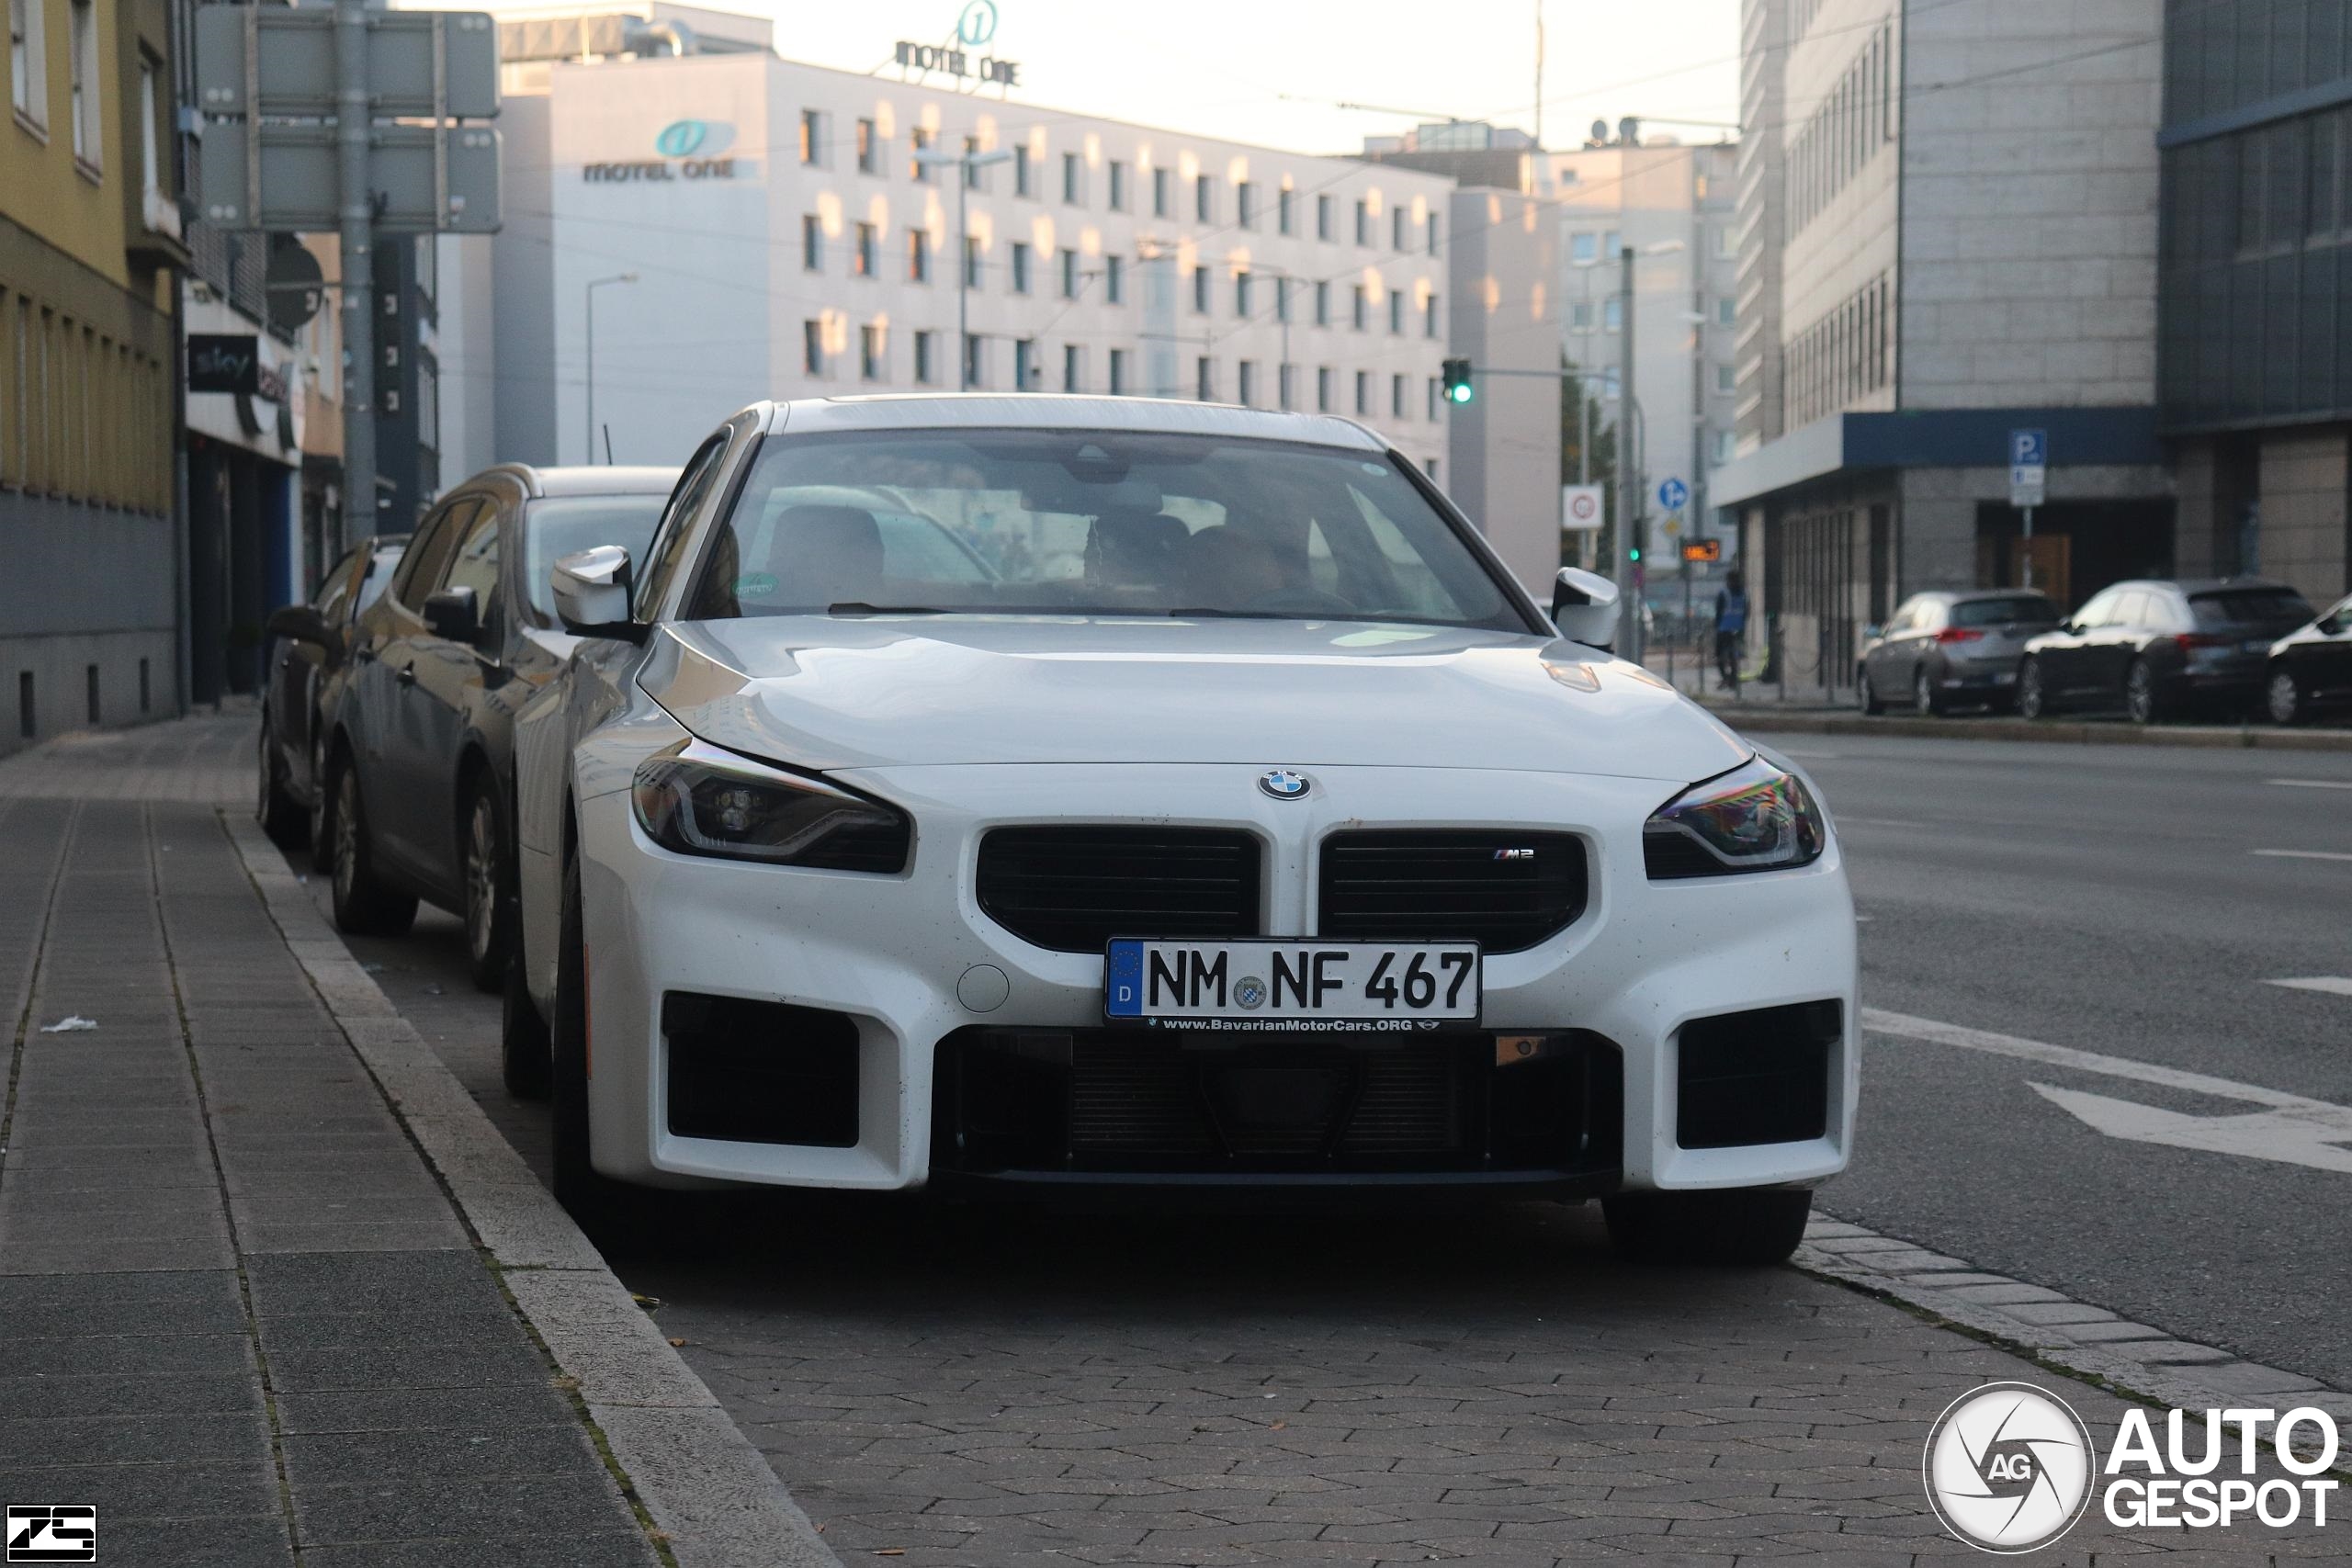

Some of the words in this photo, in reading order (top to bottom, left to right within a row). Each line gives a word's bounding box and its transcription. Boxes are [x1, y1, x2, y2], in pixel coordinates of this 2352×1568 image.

[2016, 434, 2036, 461] P
[1262, 771, 1305, 780] BMW
[1149, 949, 1227, 1008] NM
[1272, 950, 1350, 1009] NF
[1365, 952, 1474, 1010] 467
[1119, 986, 1132, 1002] D
[1163, 1019, 1413, 1032] www.BavarianMotorCars.ORG
